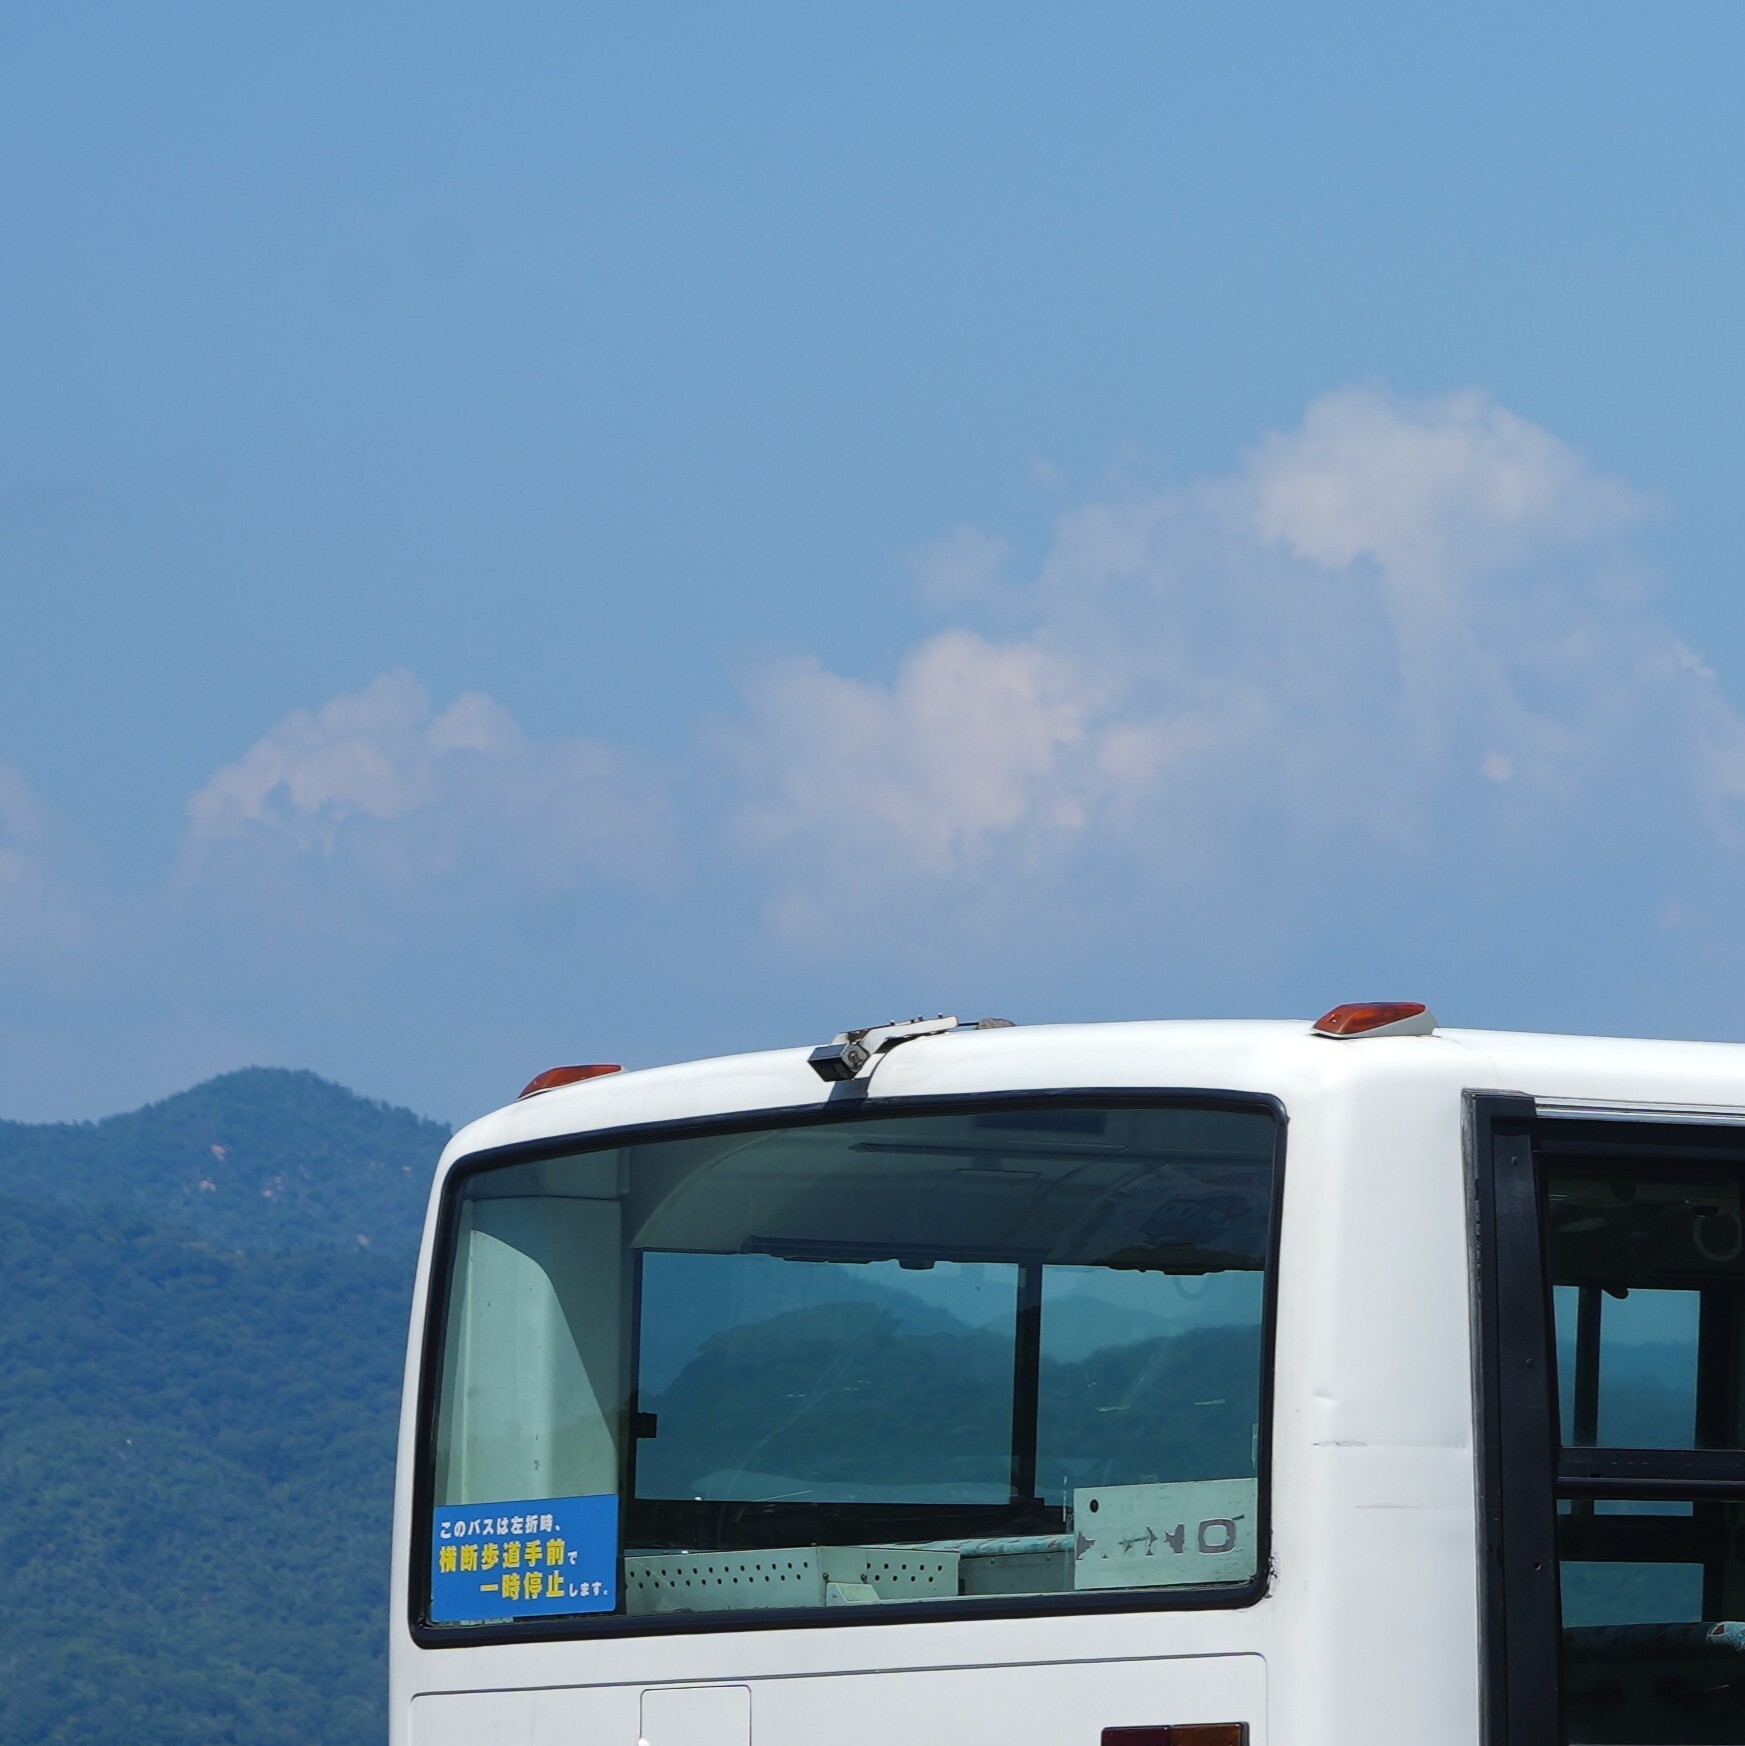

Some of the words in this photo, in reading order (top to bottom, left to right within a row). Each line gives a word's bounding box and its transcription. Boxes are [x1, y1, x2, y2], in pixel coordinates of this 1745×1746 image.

[440, 1514, 561, 1539] このバスは左折時、
[438, 1538, 577, 1573] 横断歩道手前で
[479, 1570, 609, 1601] 一時停止します。
